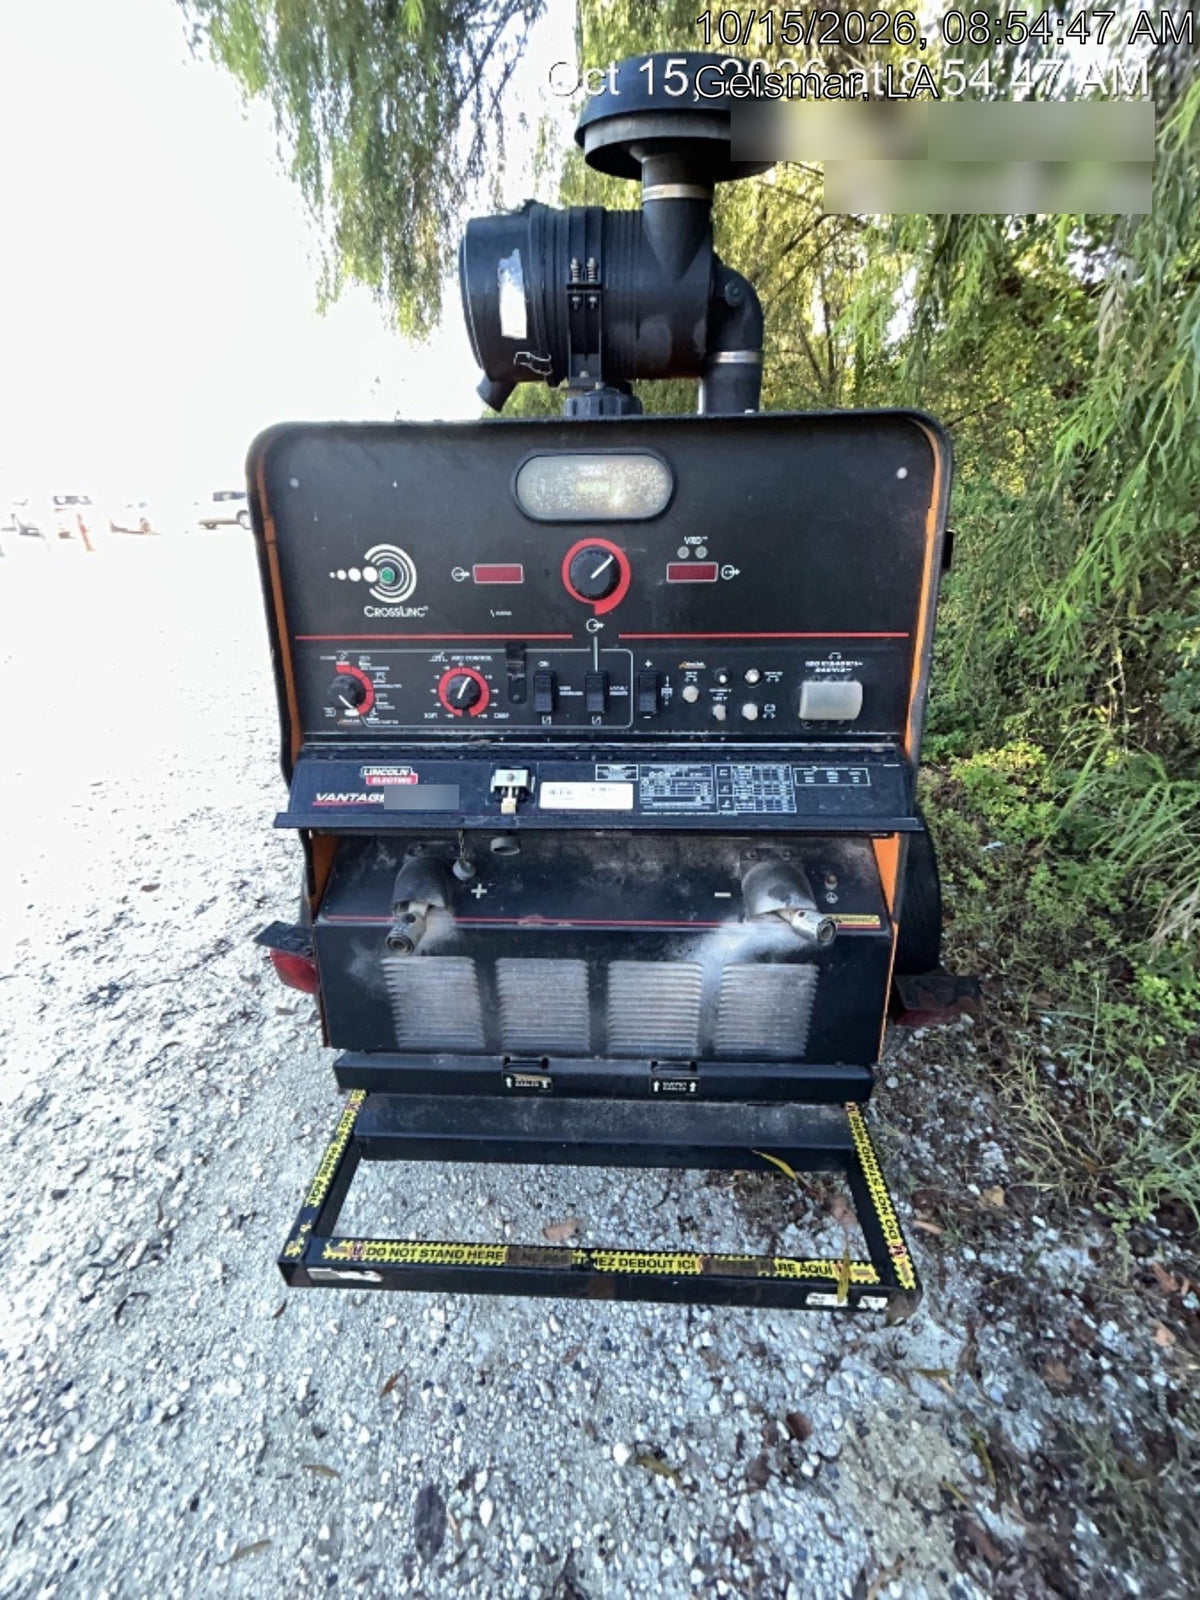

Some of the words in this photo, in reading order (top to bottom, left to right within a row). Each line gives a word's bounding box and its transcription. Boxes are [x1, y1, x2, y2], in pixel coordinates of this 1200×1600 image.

[363, 767, 411, 776] LINCOLN
[862, 1147, 882, 1187] STAND
[875, 1189, 892, 1216] NOT
[884, 1218, 899, 1240] DO
[365, 1247, 387, 1256] DO
[388, 1247, 418, 1258] NOT
[418, 1248, 466, 1259] STAND
[467, 1249, 505, 1260] HERE
[618, 1258, 675, 1268] DEBOUT
[676, 1259, 696, 1269] ICI
